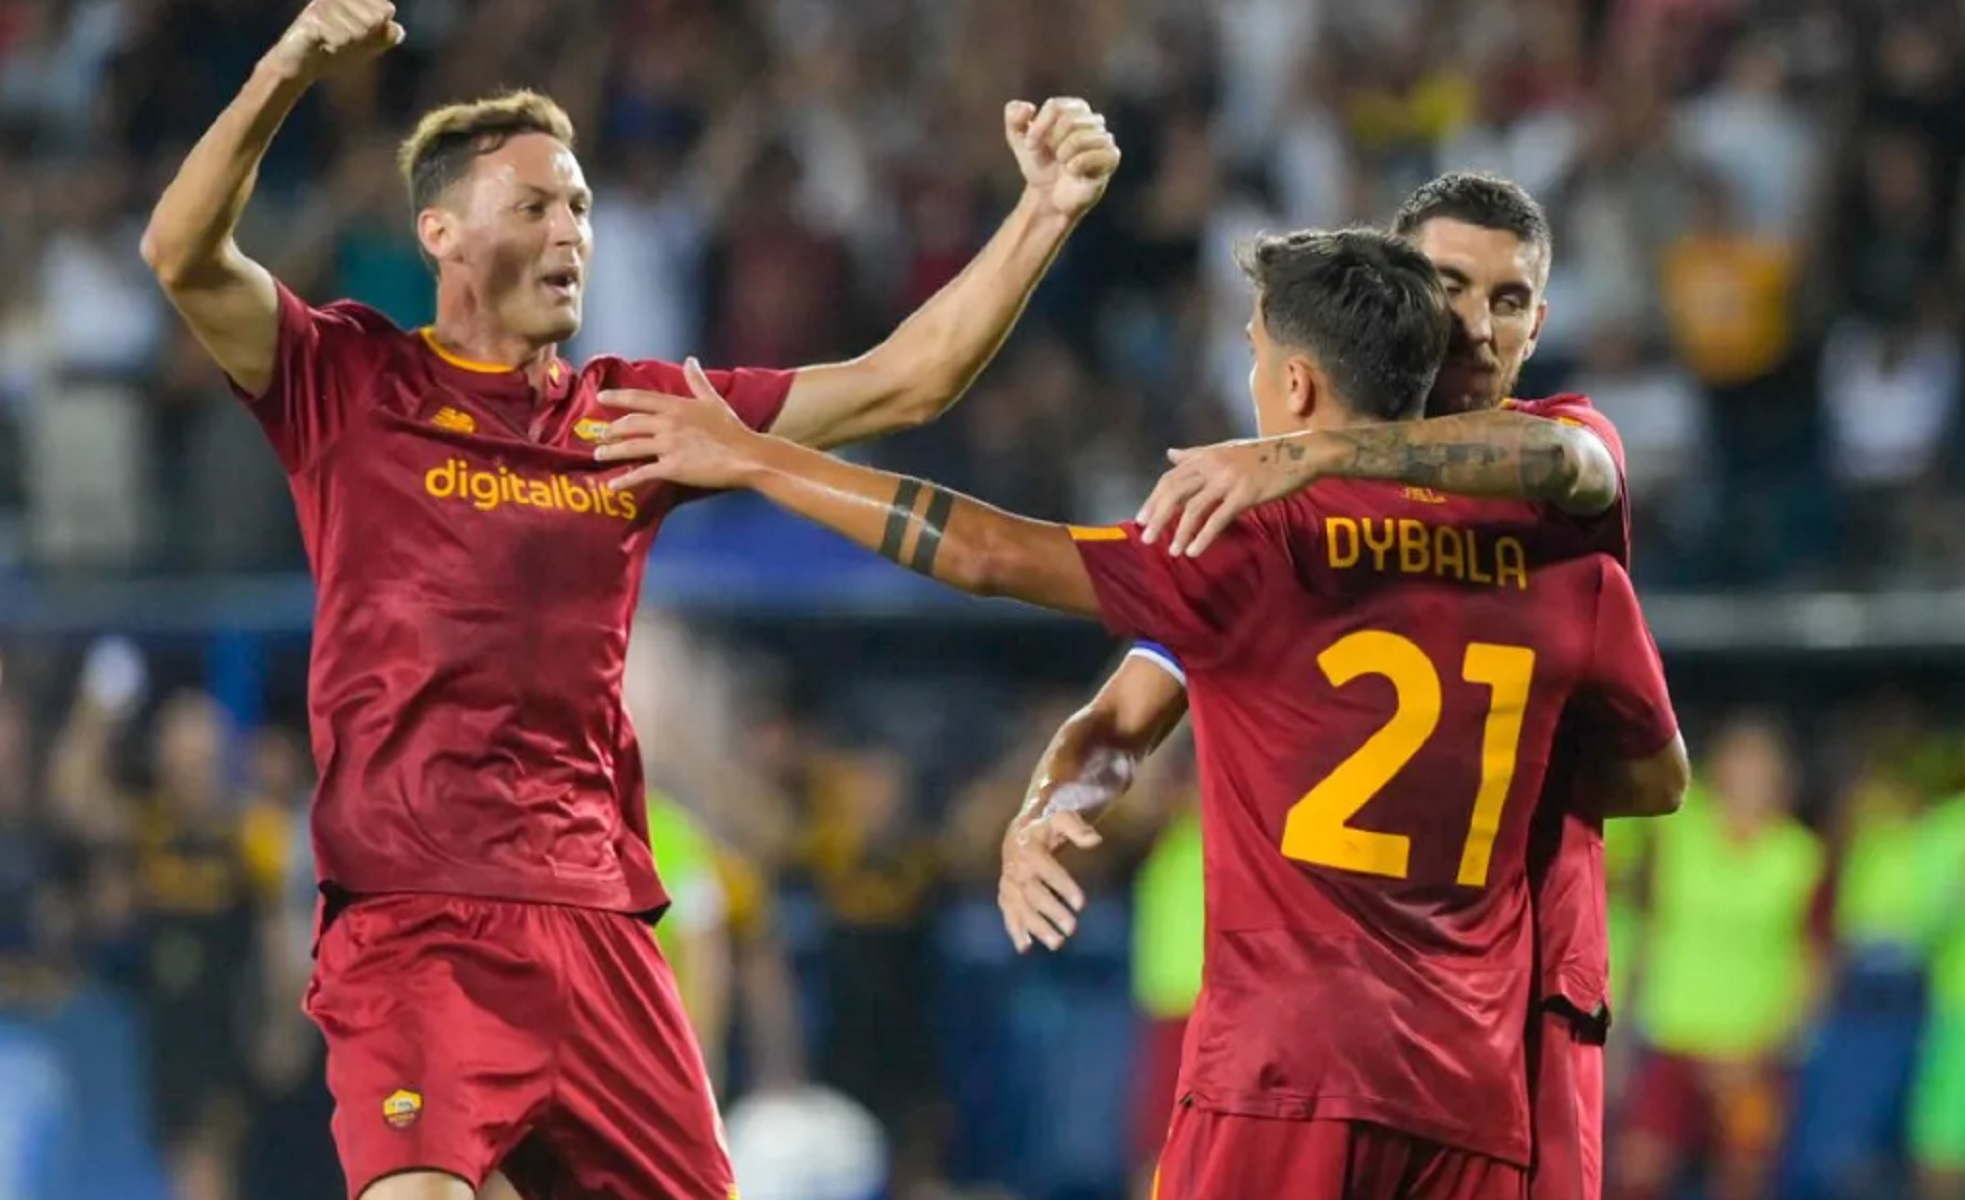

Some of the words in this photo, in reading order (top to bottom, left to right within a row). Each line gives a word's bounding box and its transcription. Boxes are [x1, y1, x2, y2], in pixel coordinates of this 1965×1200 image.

[425, 459, 637, 519] digitalbits
[1325, 517, 1528, 589] DYBALA
[1280, 629, 1536, 887] 21
